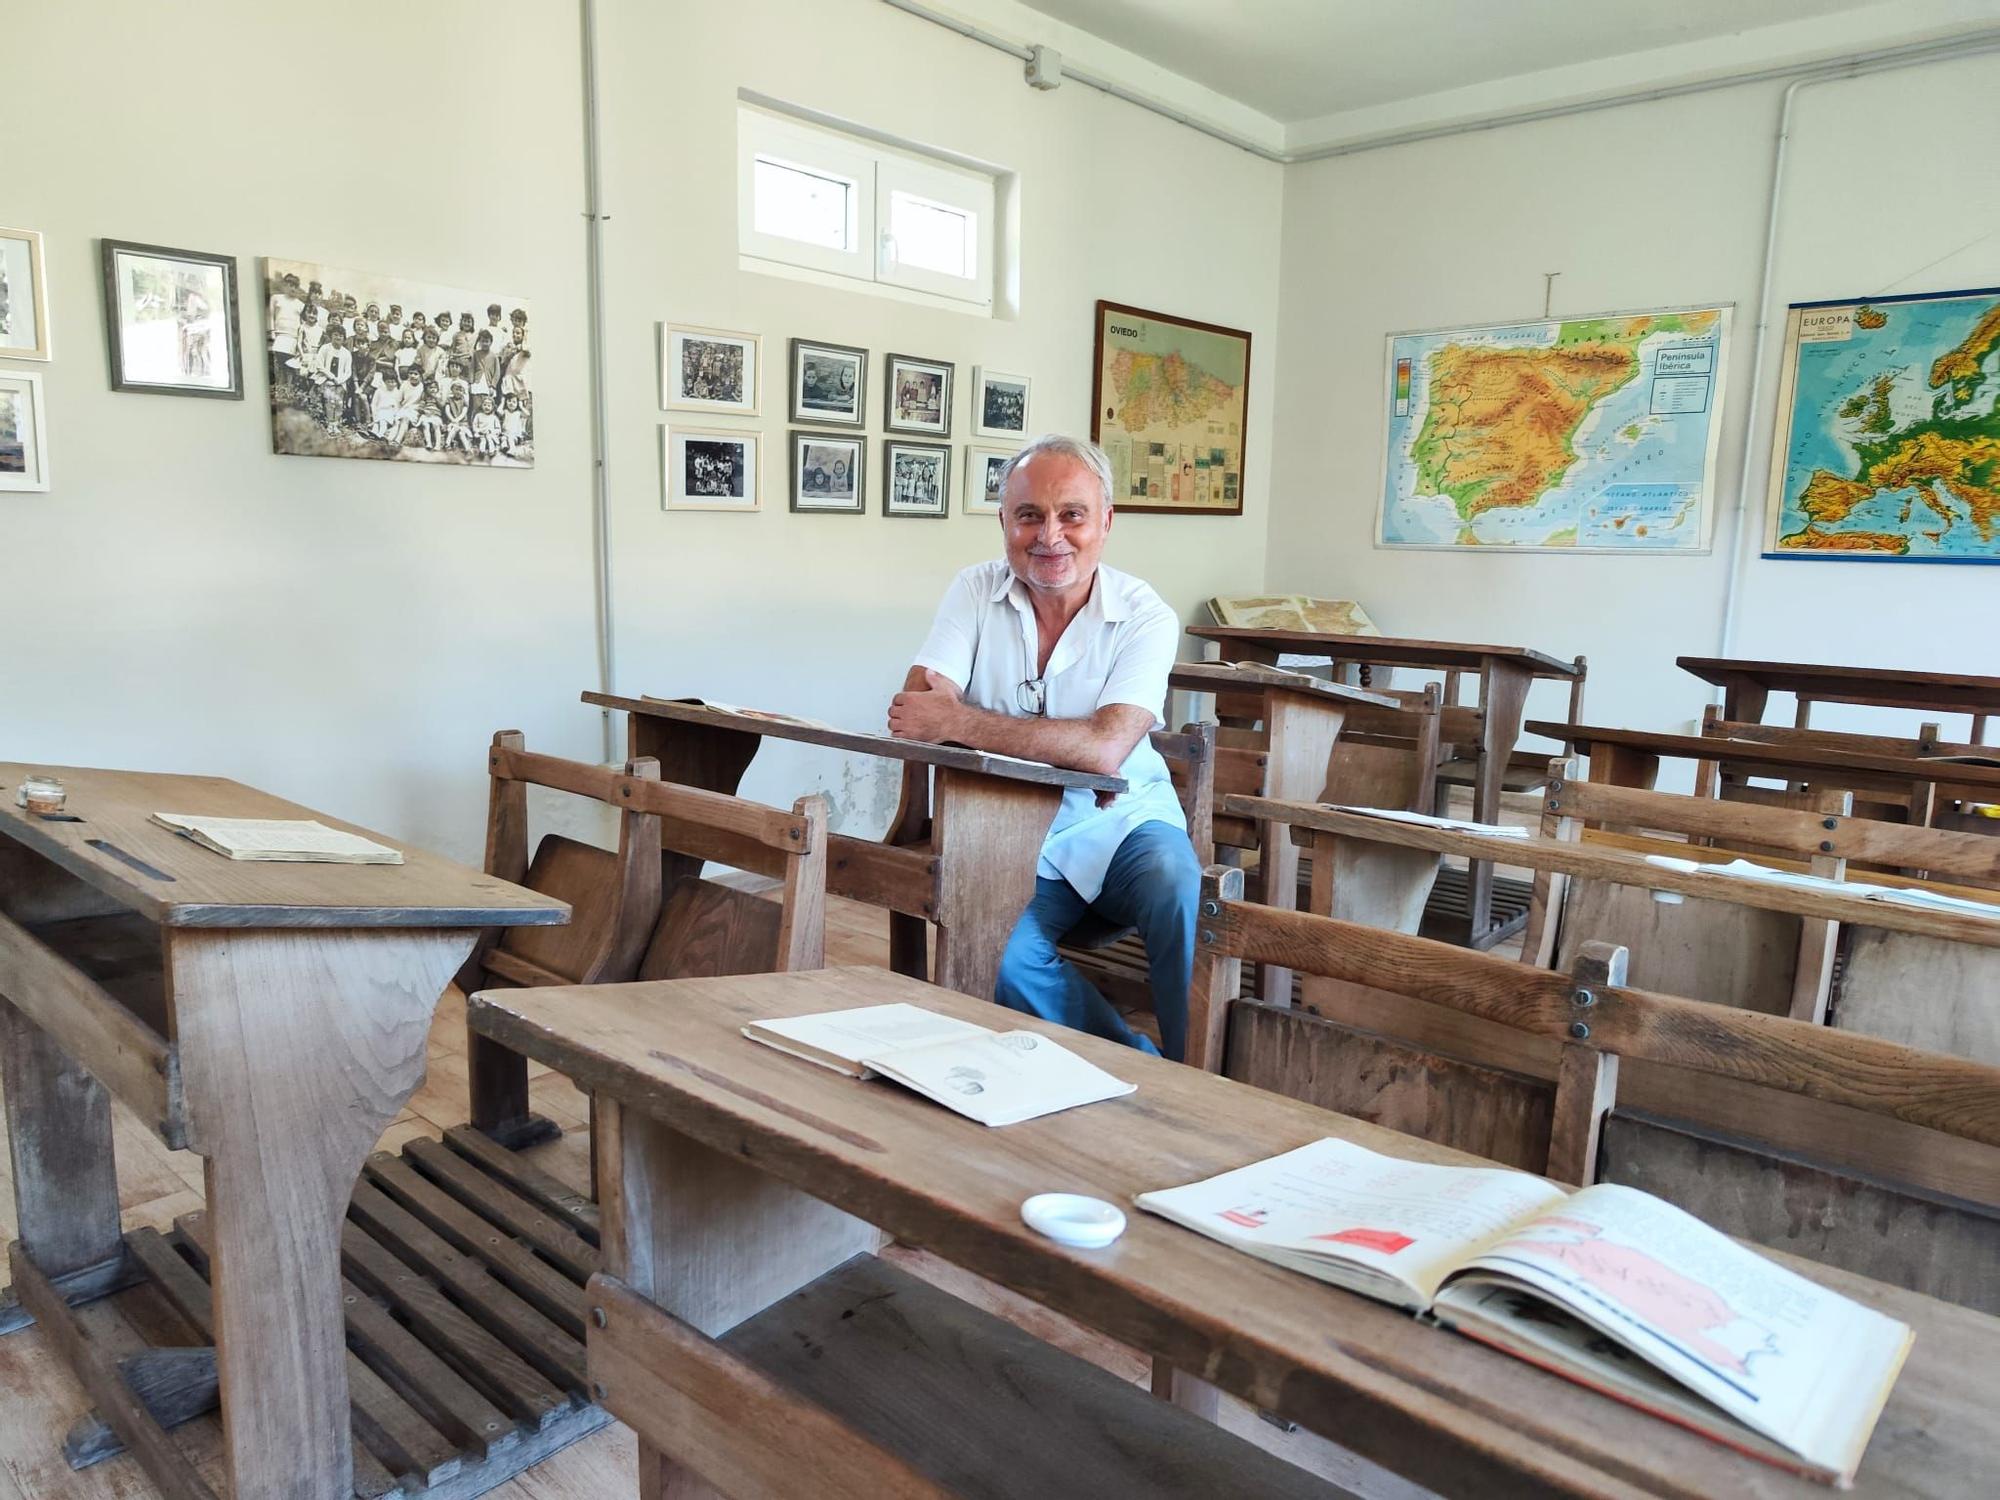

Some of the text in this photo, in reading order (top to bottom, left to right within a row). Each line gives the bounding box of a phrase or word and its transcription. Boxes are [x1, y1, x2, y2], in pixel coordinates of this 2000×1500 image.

[1803, 315, 1850, 327] EUROPA
[1110, 325, 1138, 338] OVIEDO
[1660, 351, 1705, 361] Península
[1659, 362, 1691, 371] Ibérica
